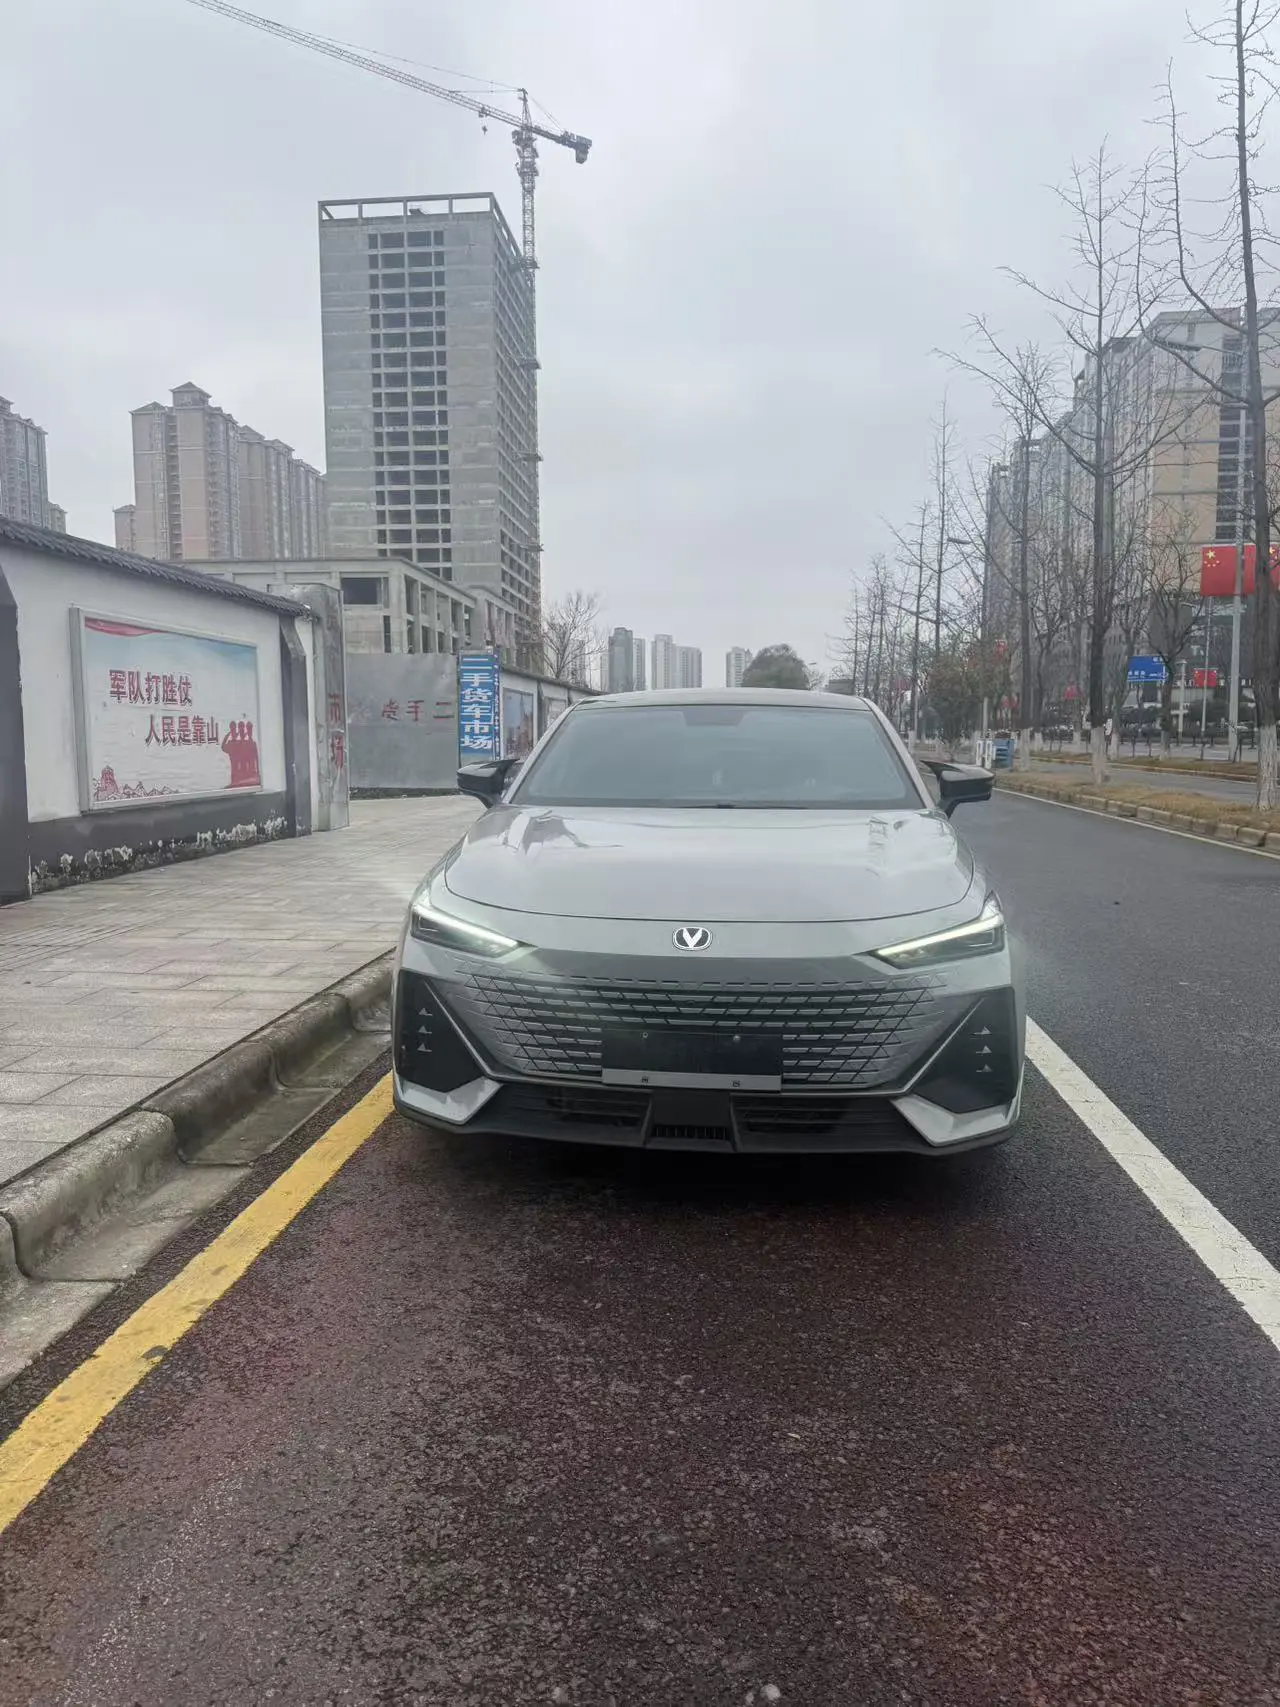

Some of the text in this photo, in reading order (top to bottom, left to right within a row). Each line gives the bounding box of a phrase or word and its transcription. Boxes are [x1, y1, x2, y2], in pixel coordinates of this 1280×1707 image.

[109, 669, 193, 706] 军队打胜仗
[460, 658, 493, 749] 二手货车市场
[145, 715, 220, 746] 人民是靠山
